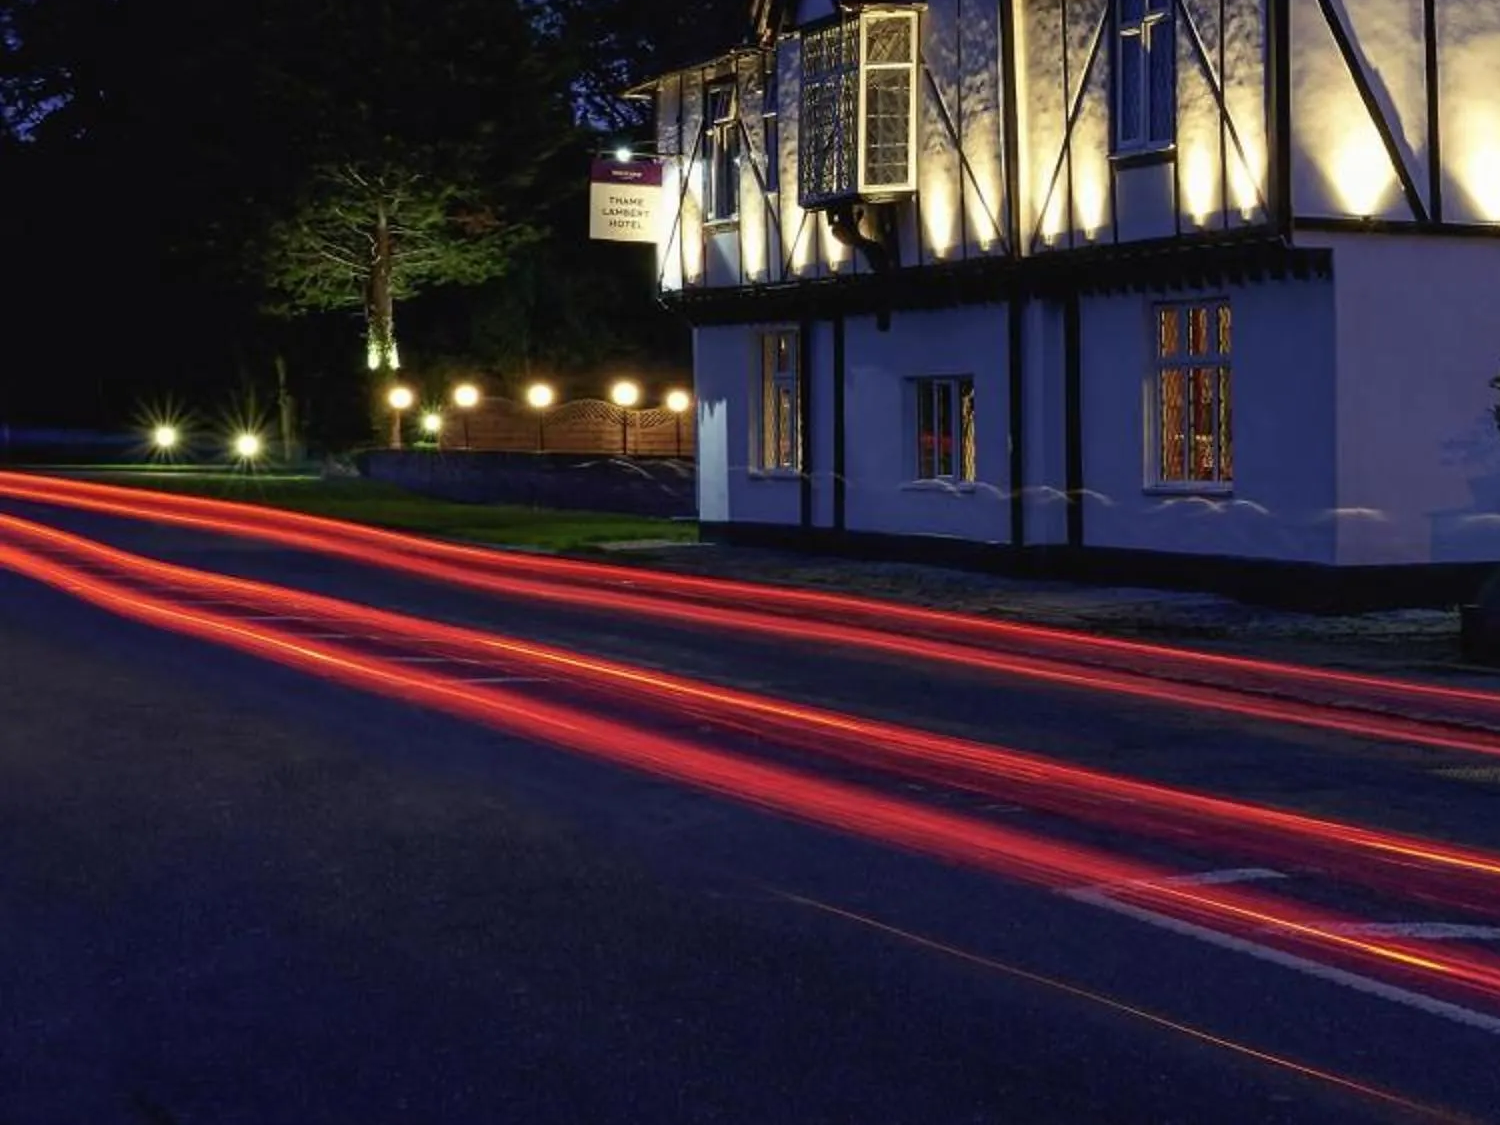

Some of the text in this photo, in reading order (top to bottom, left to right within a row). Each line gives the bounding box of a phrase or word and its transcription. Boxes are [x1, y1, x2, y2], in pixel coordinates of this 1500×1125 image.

[609, 196, 644, 205] THAME
[602, 208, 649, 217] LAMBERT
[609, 220, 642, 229] HOTEL
